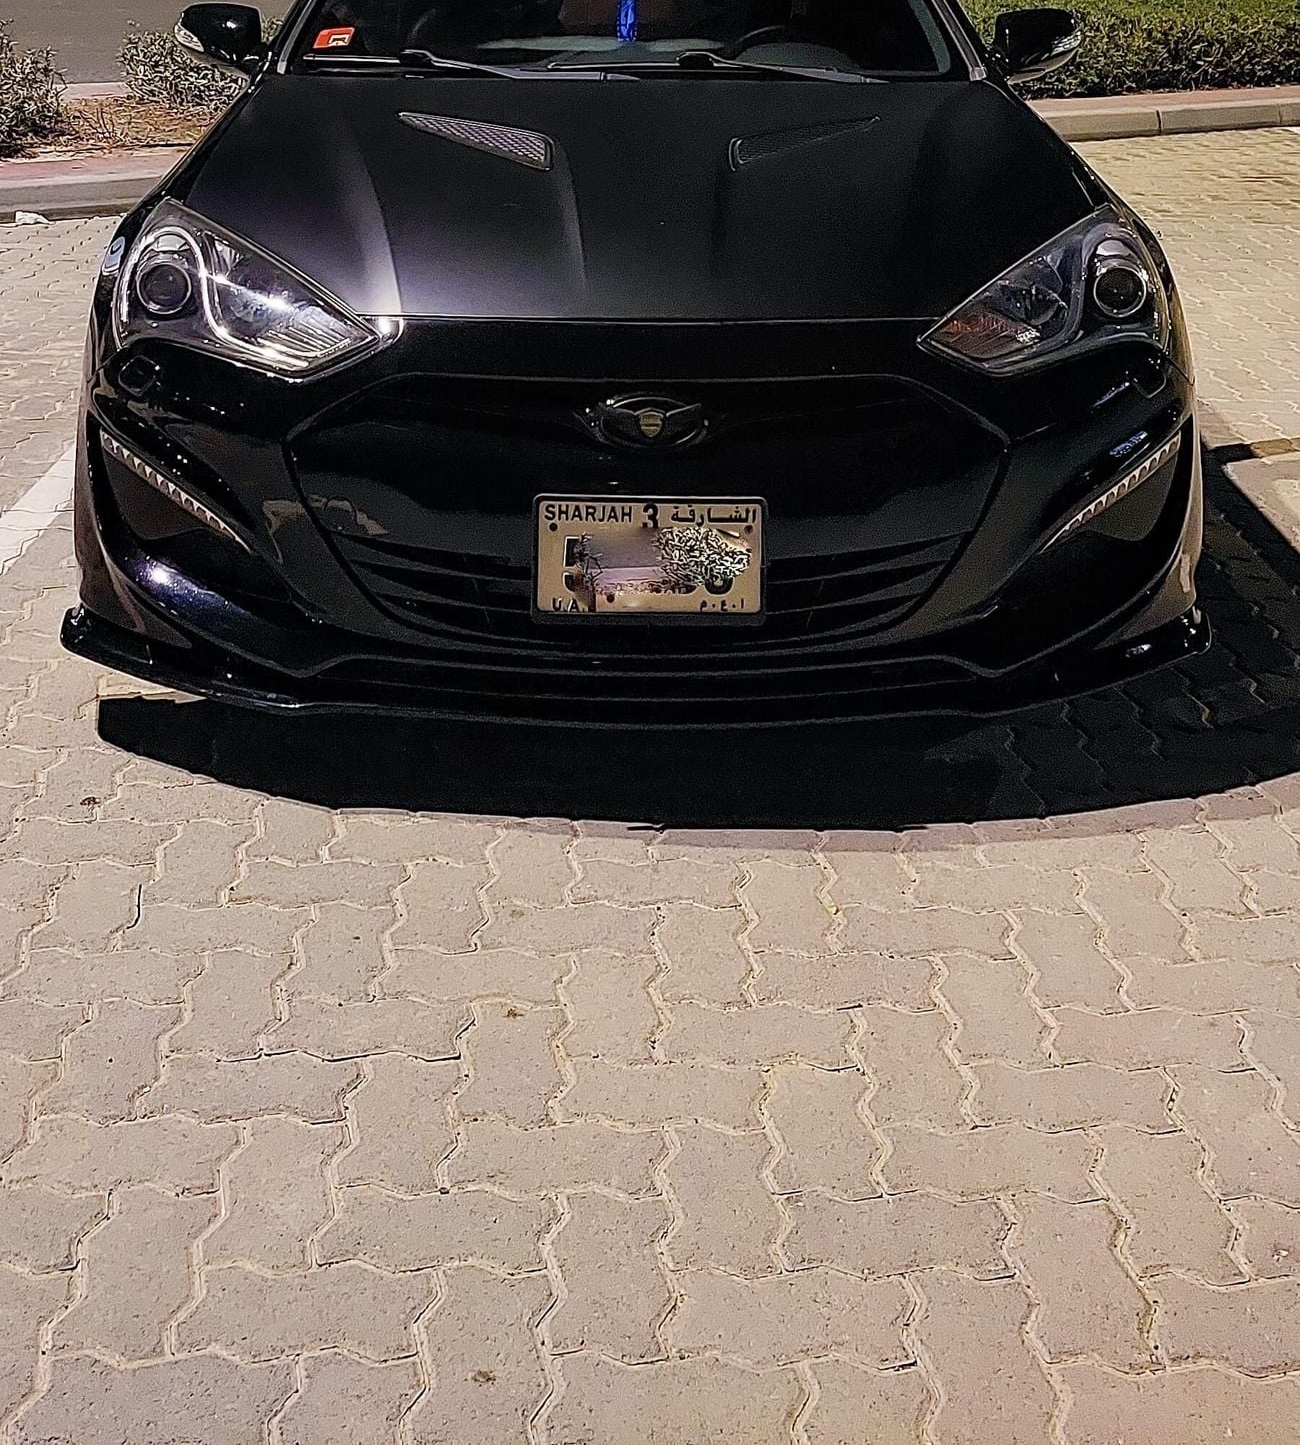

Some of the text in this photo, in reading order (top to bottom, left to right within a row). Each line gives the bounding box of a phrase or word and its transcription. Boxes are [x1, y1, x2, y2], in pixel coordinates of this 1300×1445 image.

[544, 503, 659, 528] SHARJAH 3
[671, 505, 757, 527] الشارقة
